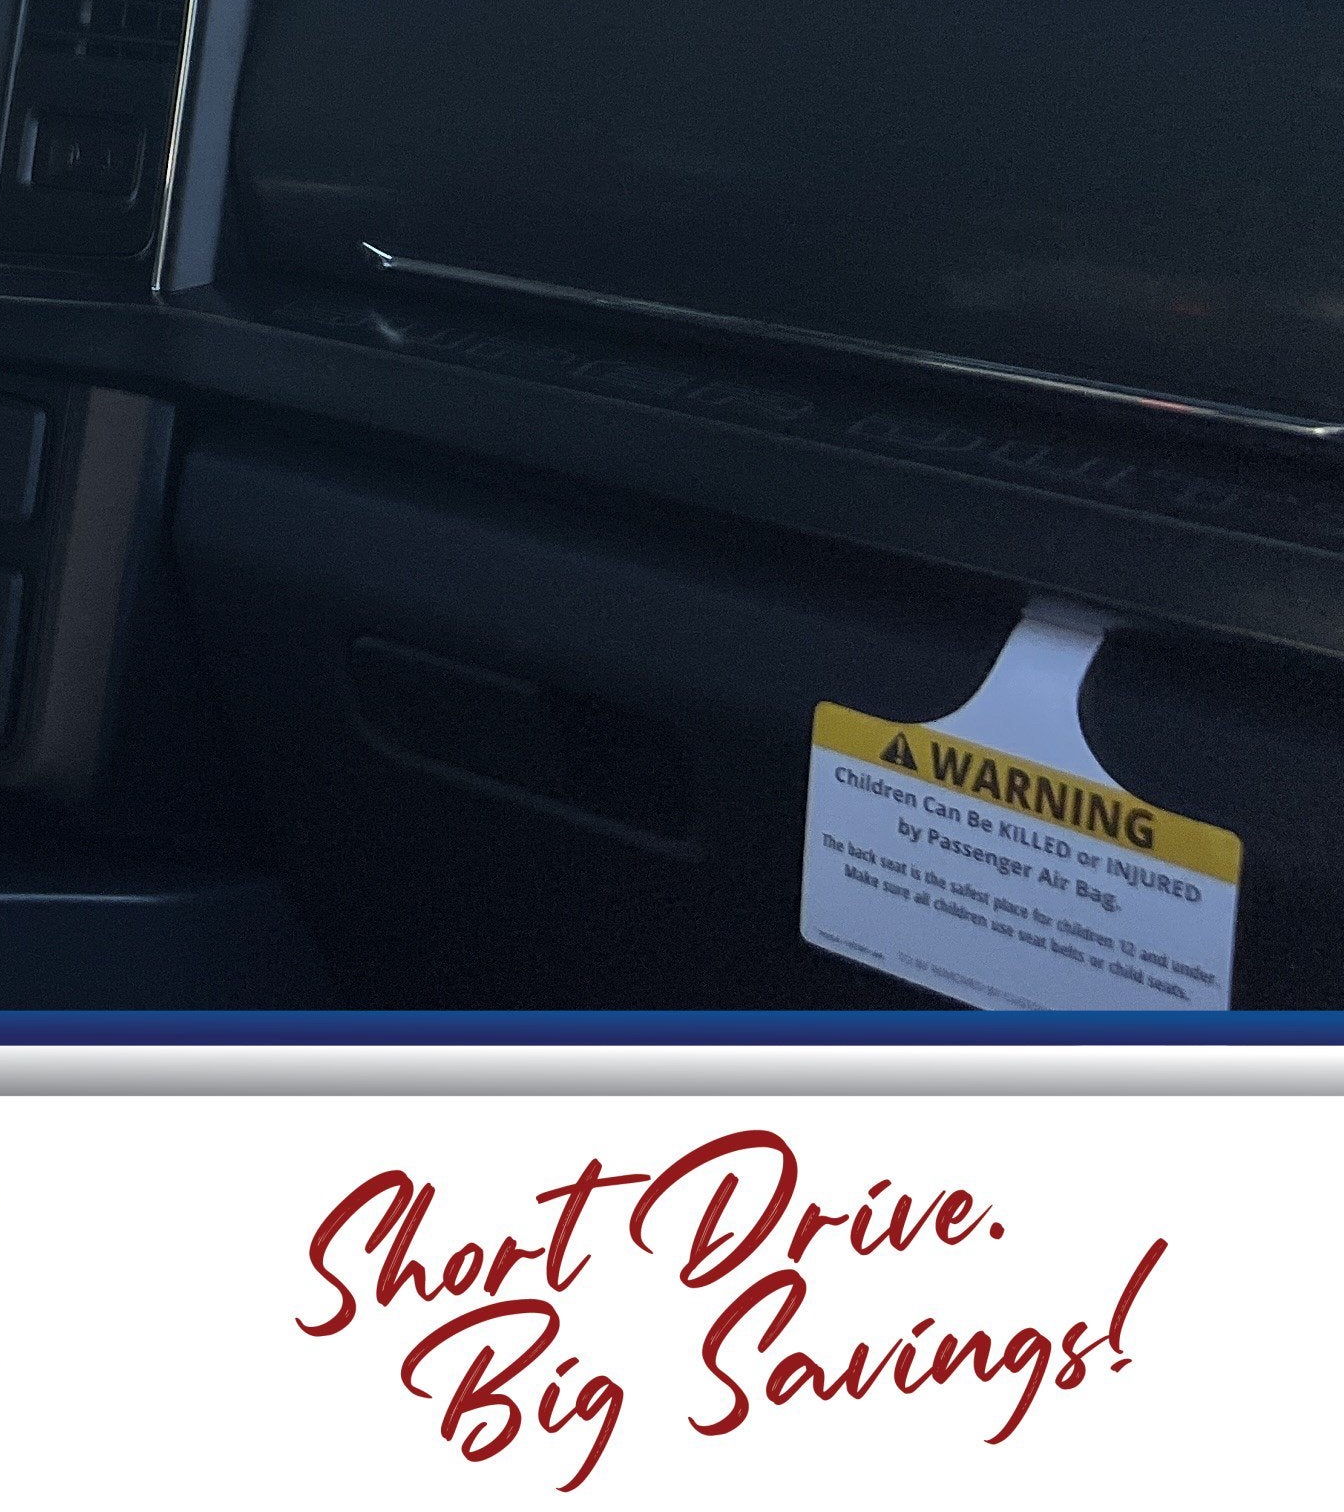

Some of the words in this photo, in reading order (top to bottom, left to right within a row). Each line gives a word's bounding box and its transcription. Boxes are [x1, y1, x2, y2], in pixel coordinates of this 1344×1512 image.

[834, 766, 918, 808] Children
[923, 795, 961, 822] Can
[967, 809, 993, 833] Be
[999, 820, 1071, 858] KILLED
[1077, 850, 1102, 868] or
[1106, 857, 1202, 902] INJURED
[931, 741, 1156, 849] WARNING
[822, 832, 845, 852] The
[848, 840, 876, 865] back
[925, 871, 946, 889] the
[844, 863, 880, 888] Make
[933, 898, 988, 928] children
[898, 816, 922, 843] by
[927, 828, 1032, 878] Passenger
[1038, 867, 1070, 891] Air
[1075, 878, 1122, 913] Bag.
